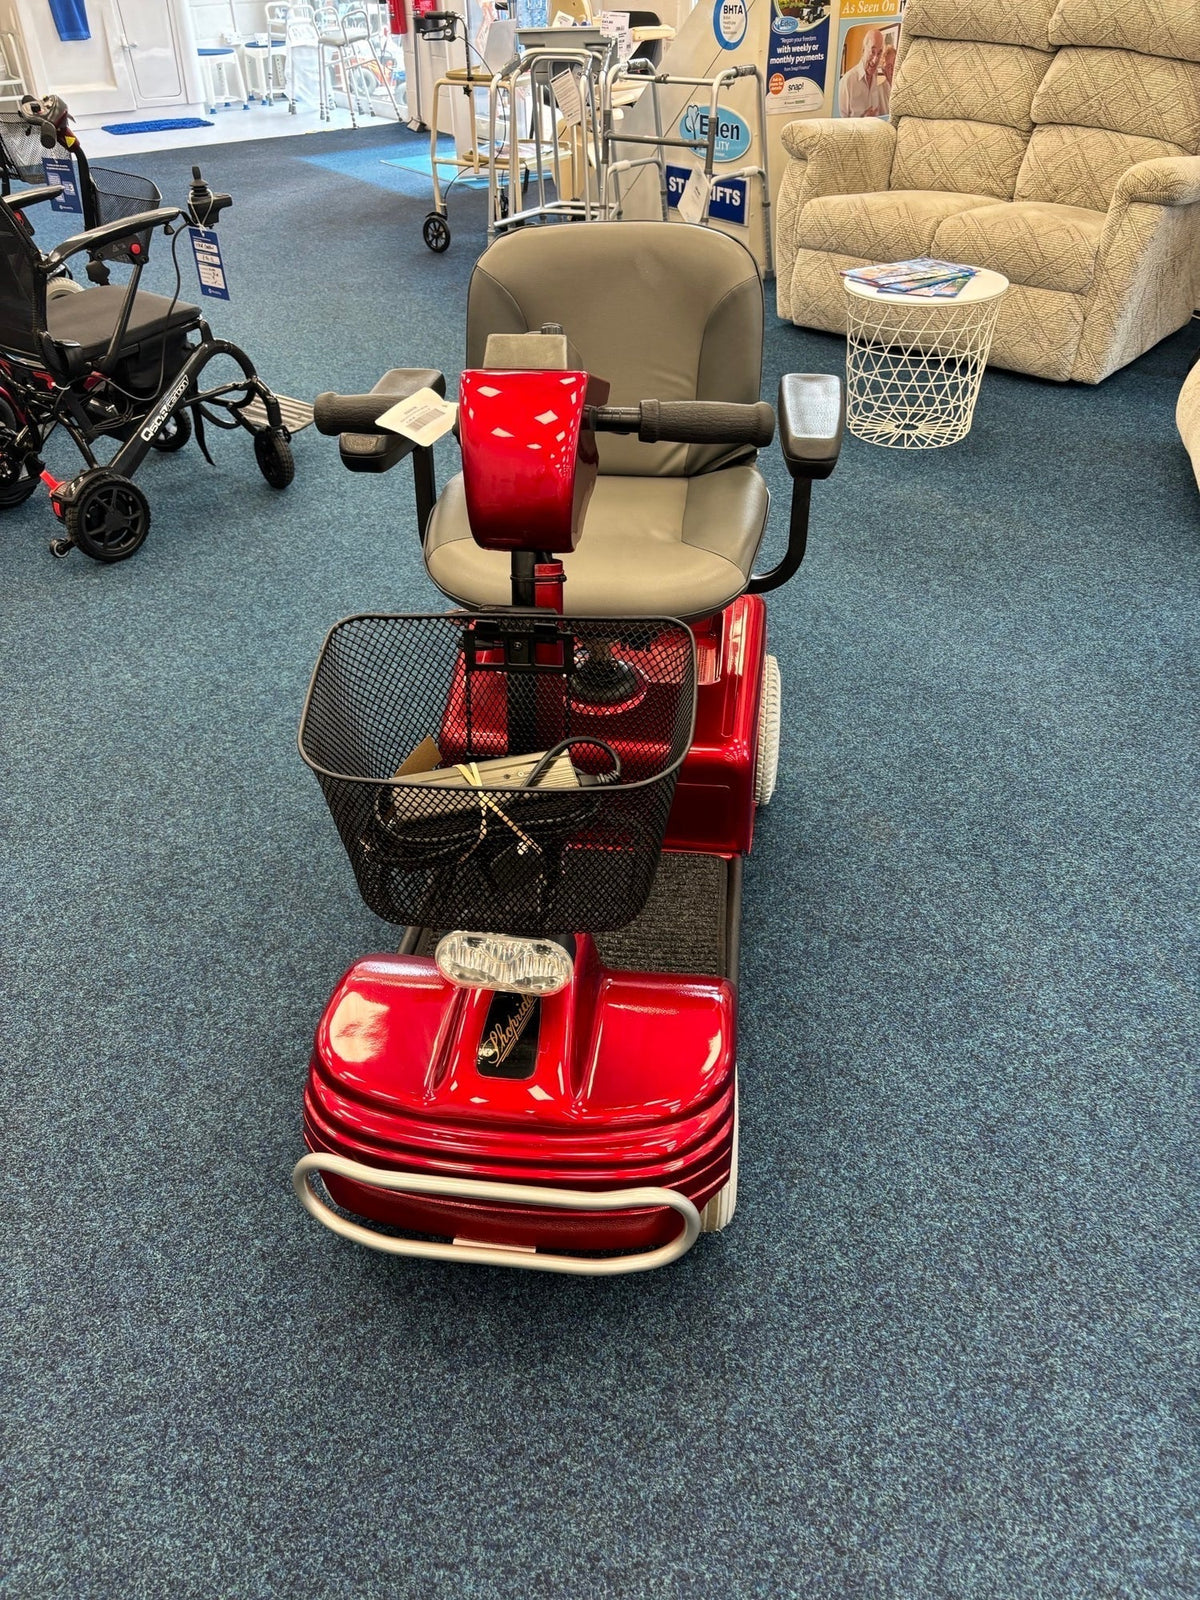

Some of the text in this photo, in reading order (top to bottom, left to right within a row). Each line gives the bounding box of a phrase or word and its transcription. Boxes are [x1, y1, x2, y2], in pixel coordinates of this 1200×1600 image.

[723, 5, 743, 14] BHTA
[842, 2, 856, 14] As
[857, 0, 879, 13] Seen
[881, 0, 895, 12] On
[777, 45, 791, 54] with
[791, 43, 812, 53] weekly
[770, 53, 825, 64] monthly payments
[787, 82, 804, 92] snap!
[668, 176, 741, 207] STIFTS
